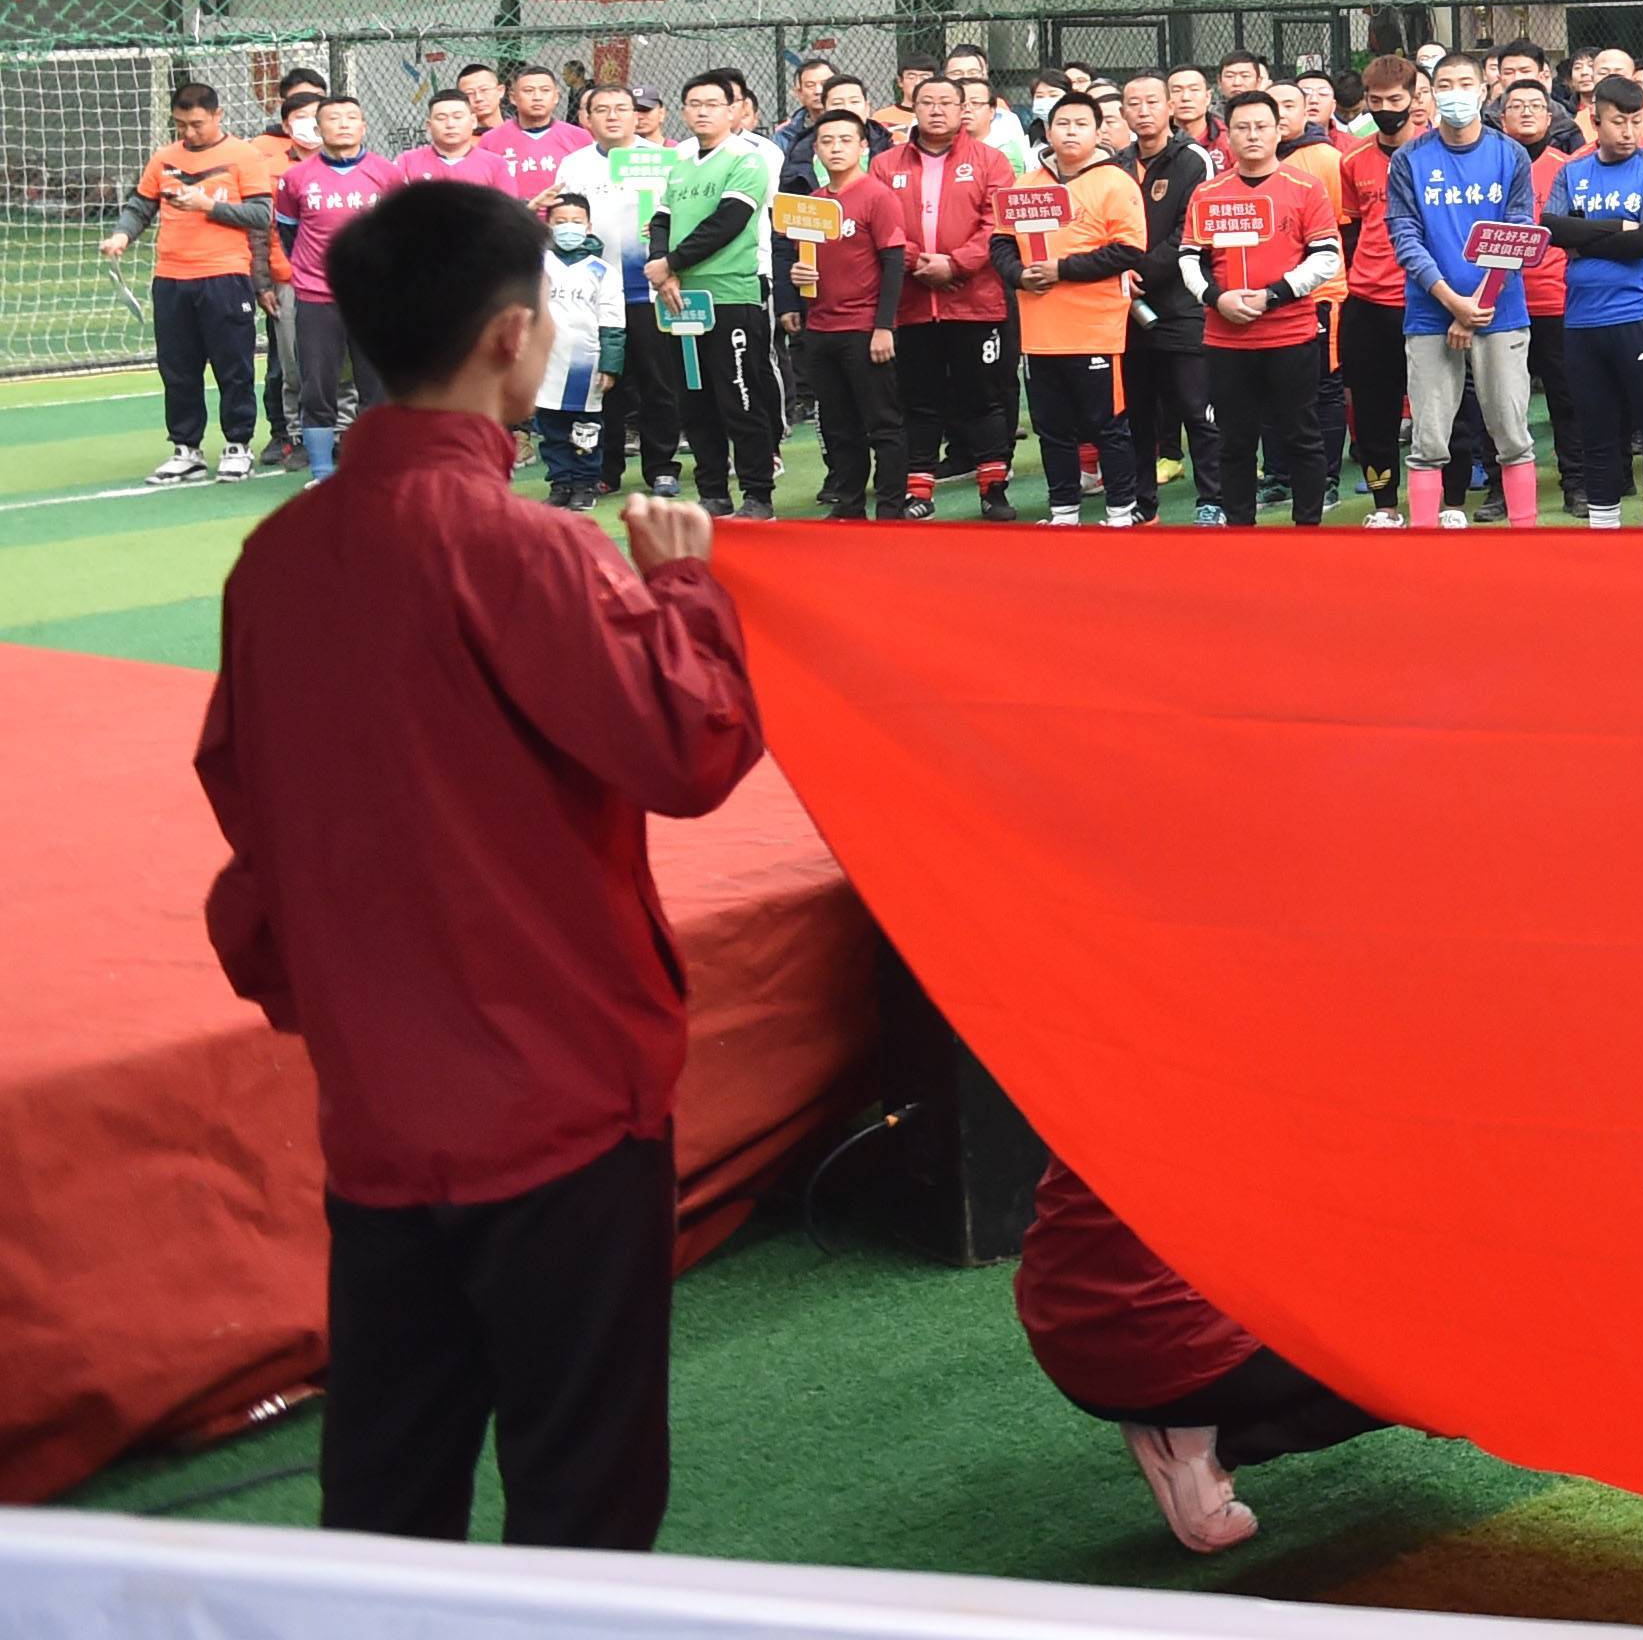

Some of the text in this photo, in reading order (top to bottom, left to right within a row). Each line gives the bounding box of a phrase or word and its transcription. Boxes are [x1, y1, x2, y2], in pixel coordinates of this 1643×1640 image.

[1424, 183, 1503, 206] 河北体彩
[1573, 190, 1642, 213] 河北体彩
[1005, 205, 1063, 220] 足球俱乐部
[1204, 218, 1264, 232] 足球俱乐部
[1475, 242, 1537, 257] 足球俱乐部
